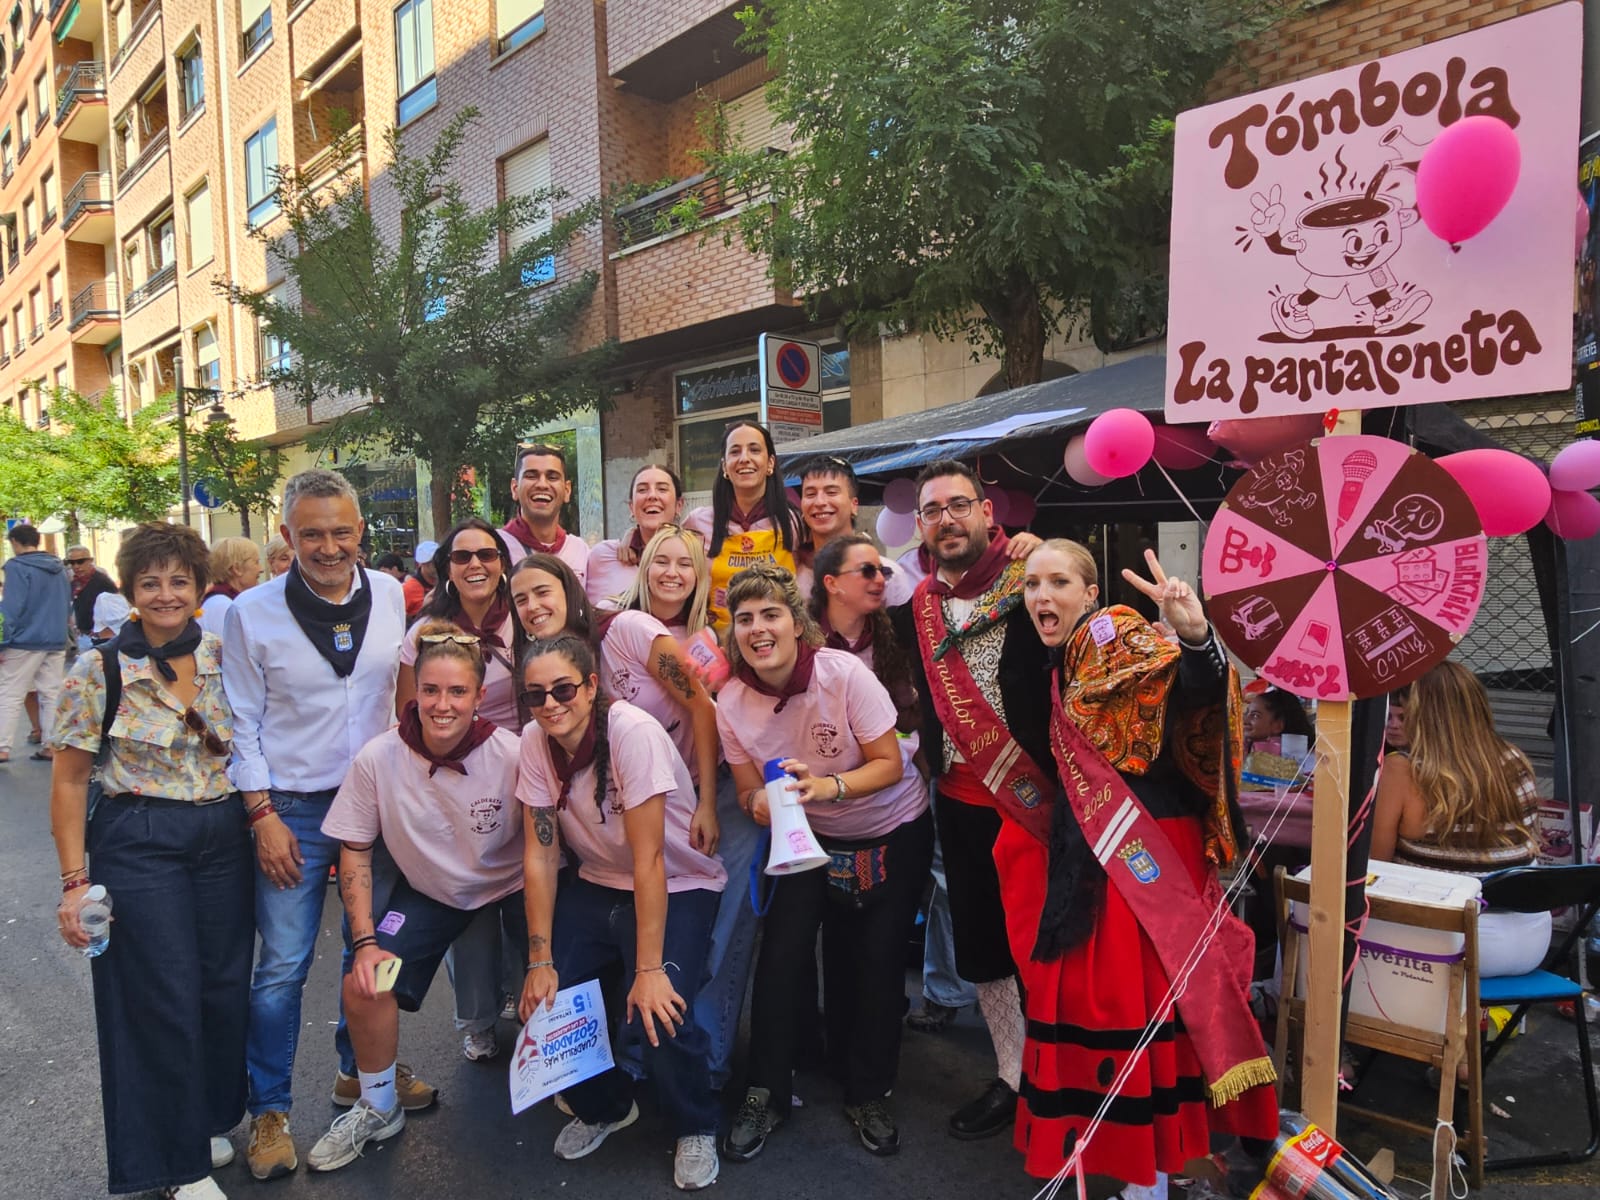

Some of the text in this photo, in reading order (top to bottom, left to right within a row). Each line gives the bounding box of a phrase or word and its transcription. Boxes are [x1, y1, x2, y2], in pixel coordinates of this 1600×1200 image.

[1209, 57, 1521, 190] Tómbola
[1174, 342, 1234, 404] La
[1240, 310, 1542, 414] pantaloneta
[1436, 543, 1481, 628] BLACKJACK
[1377, 633, 1427, 677] BINGO
[970, 726, 1000, 757] 2026
[1083, 783, 1112, 823] 2026
[573, 995, 585, 1014] 5
[542, 1020, 598, 1056] GOZADORA
[560, 1034, 597, 1060] CUADRILLA
